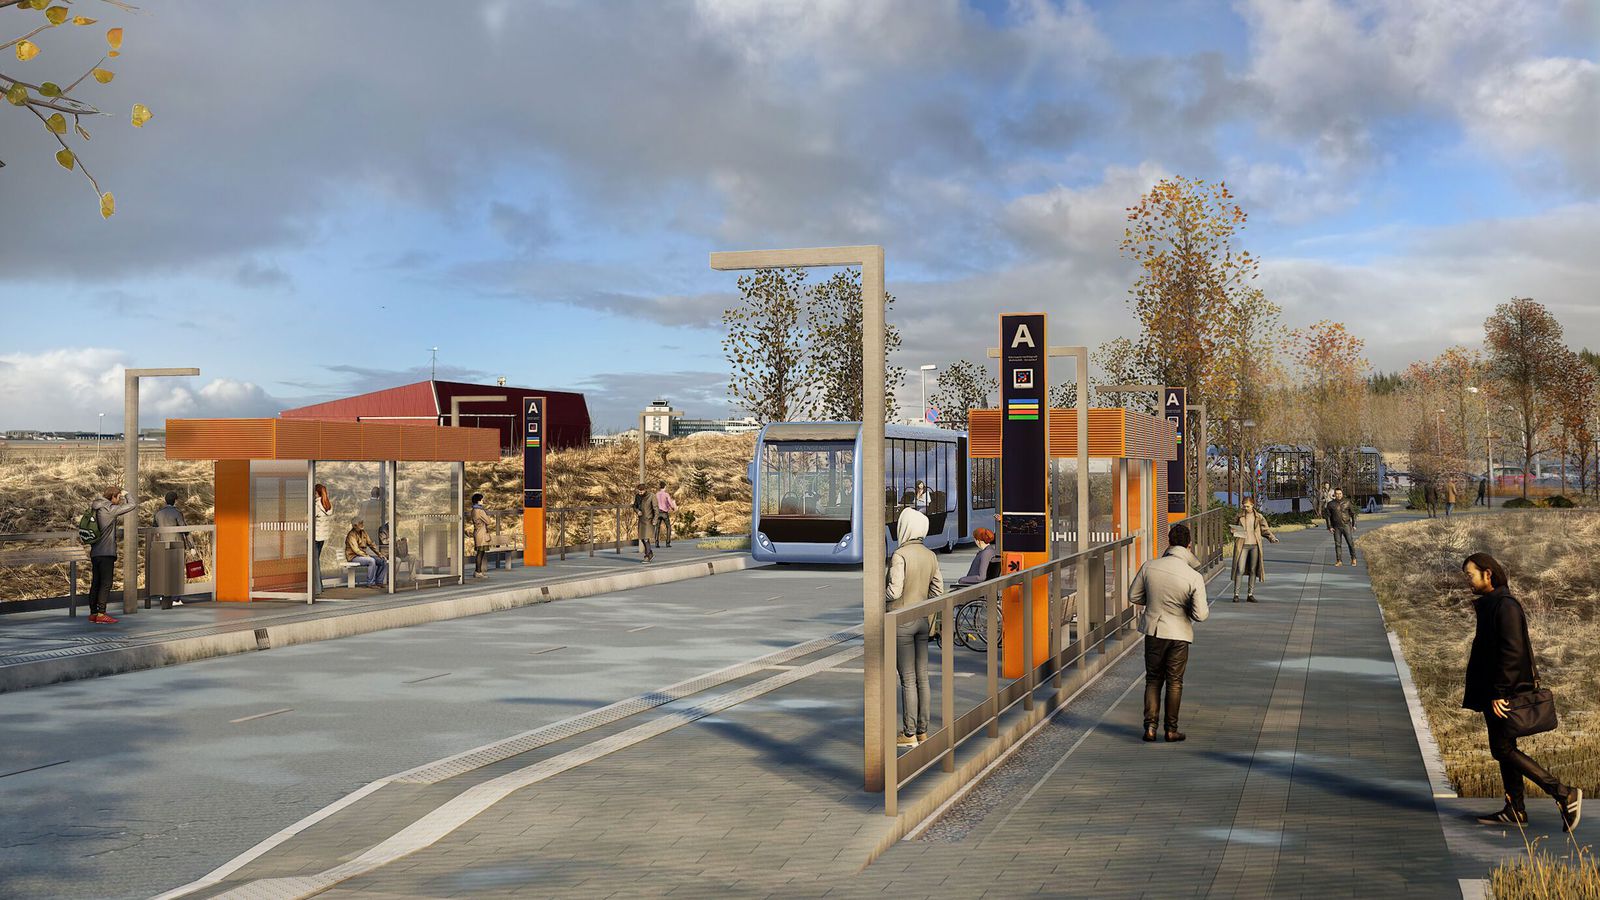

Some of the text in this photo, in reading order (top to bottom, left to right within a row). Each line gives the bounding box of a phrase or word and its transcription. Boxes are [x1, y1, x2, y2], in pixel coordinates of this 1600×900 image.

[1011, 324, 1036, 348] A
[1166, 393, 1179, 405] A
[528, 402, 538, 413] A
